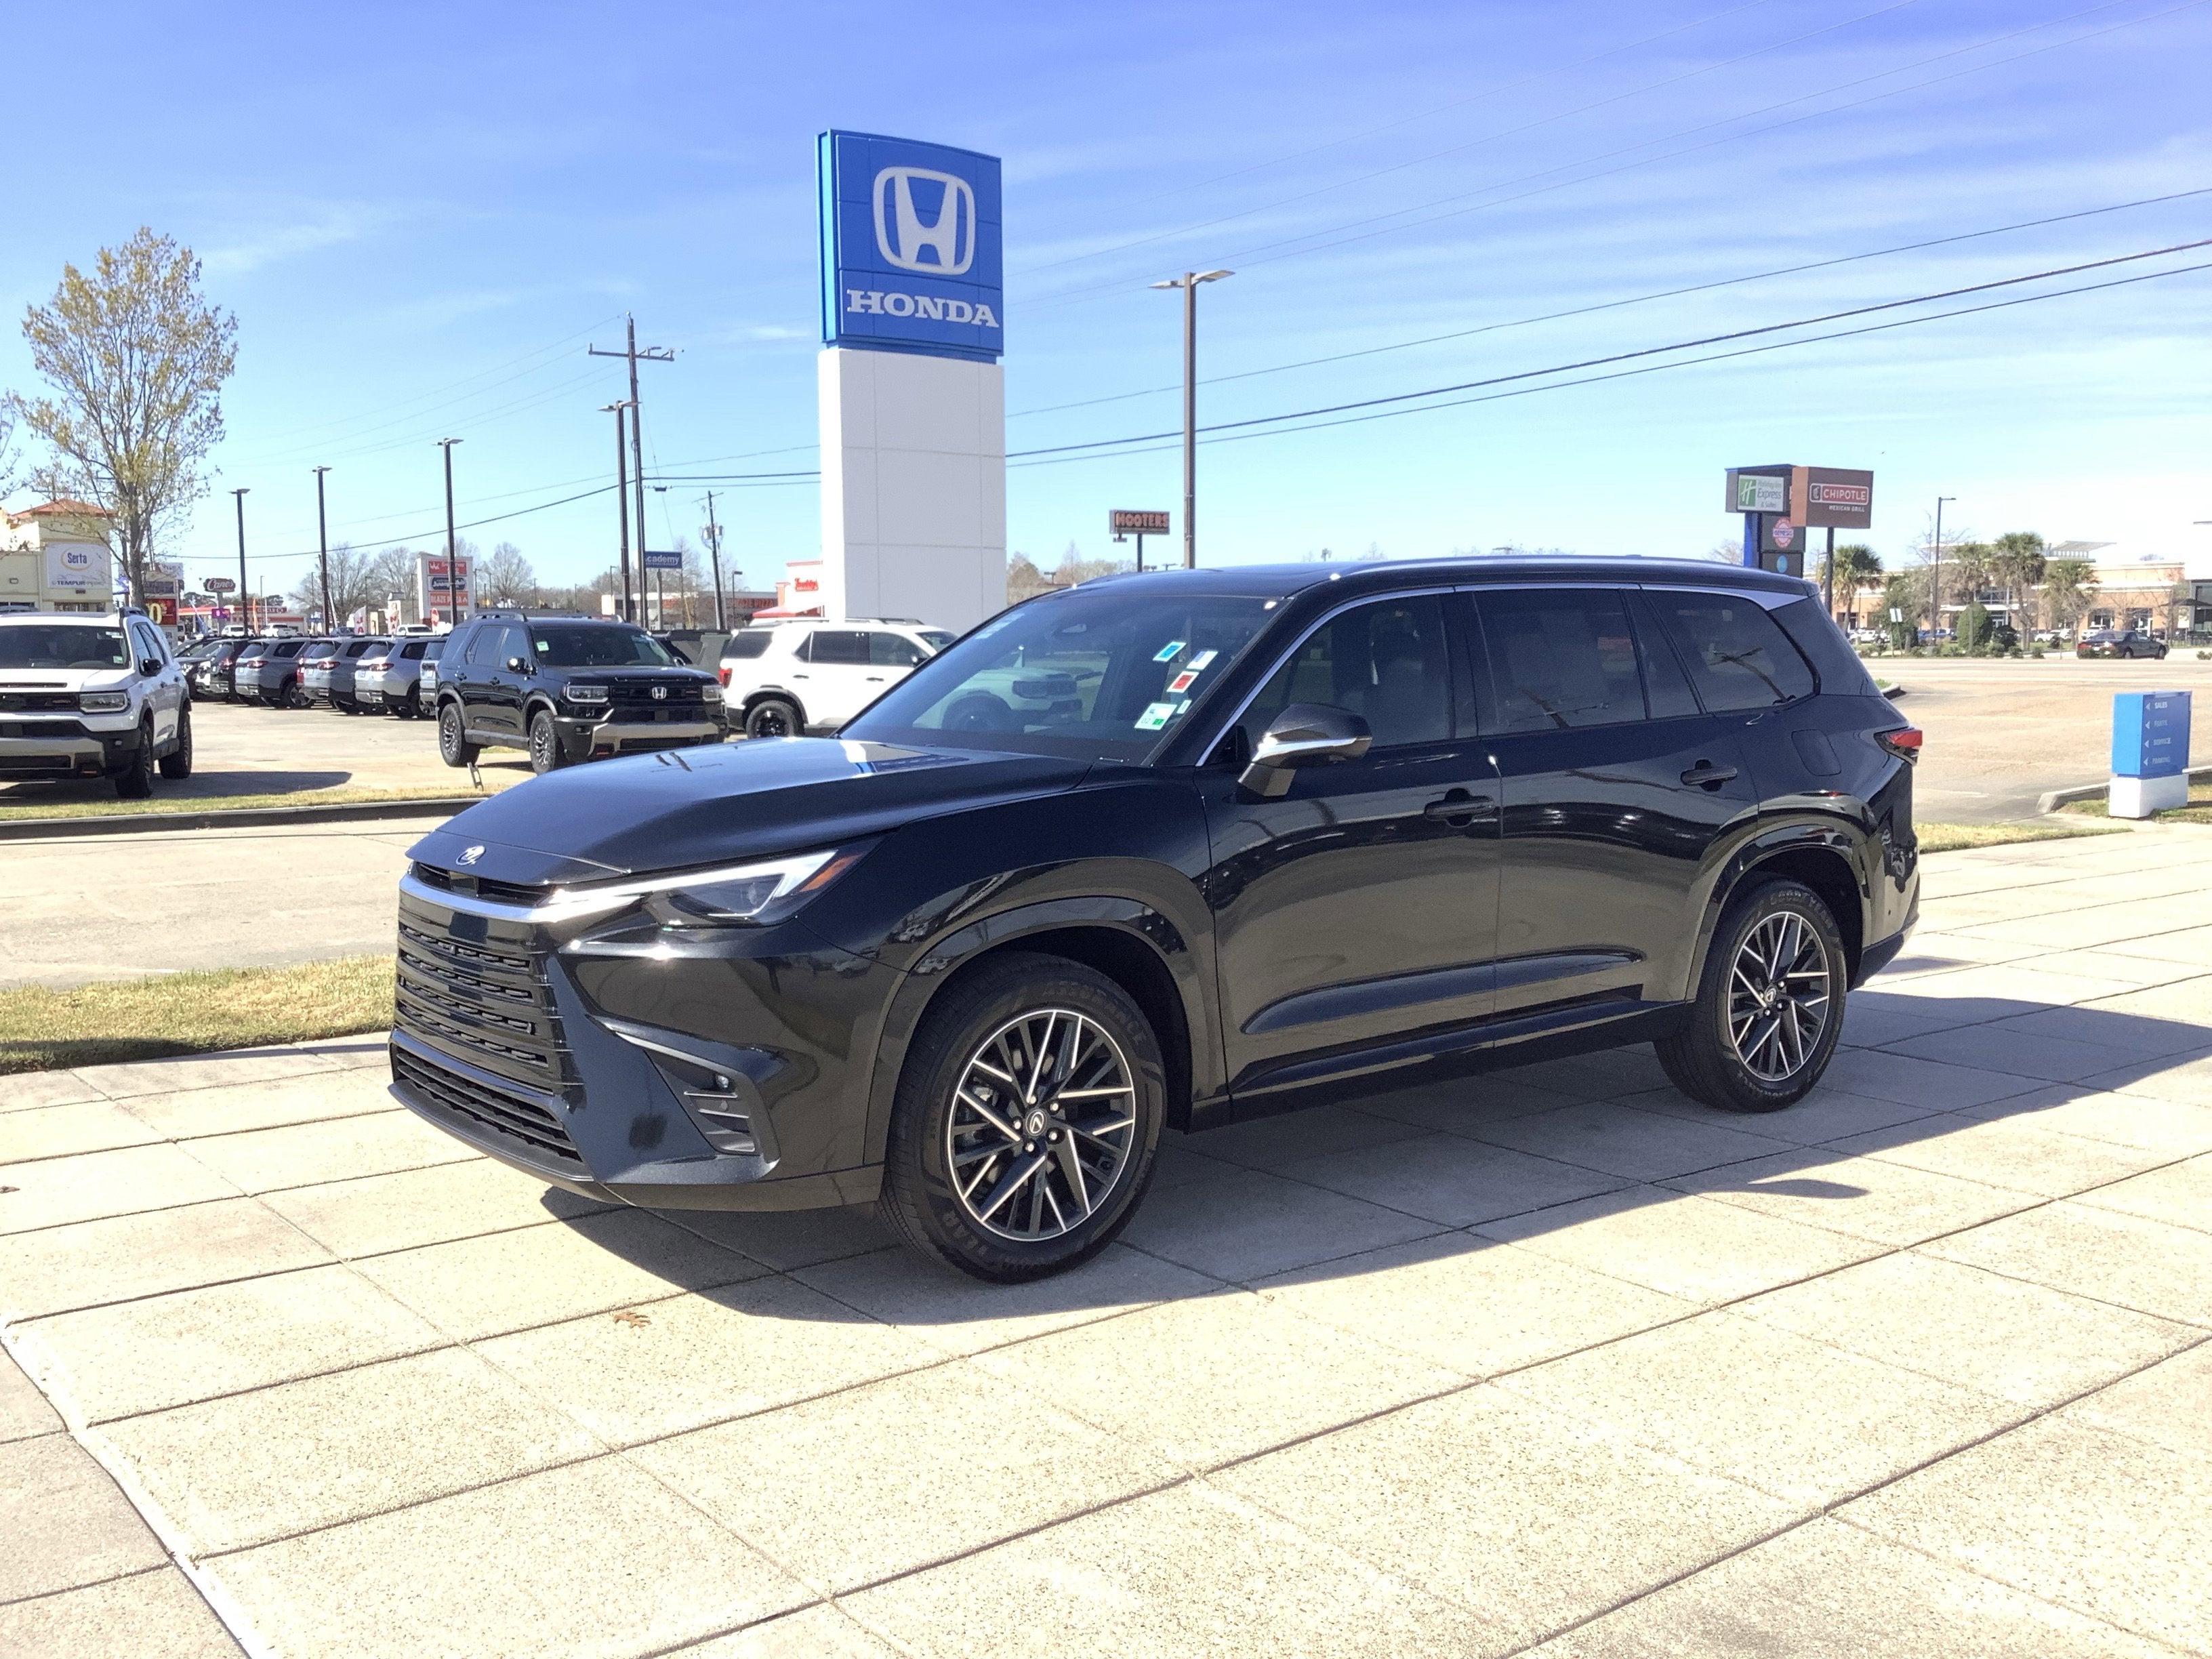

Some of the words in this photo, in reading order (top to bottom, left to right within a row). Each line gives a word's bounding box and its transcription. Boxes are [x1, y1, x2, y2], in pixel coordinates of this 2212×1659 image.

[846, 289, 1000, 328] HONDA
[1757, 487, 1782, 499] Express
[1823, 489, 1866, 501] CHIPOTLE
[1115, 512, 1168, 527] HOOTERS
[67, 552, 87, 564] Serta
[645, 554, 679, 565] cademy
